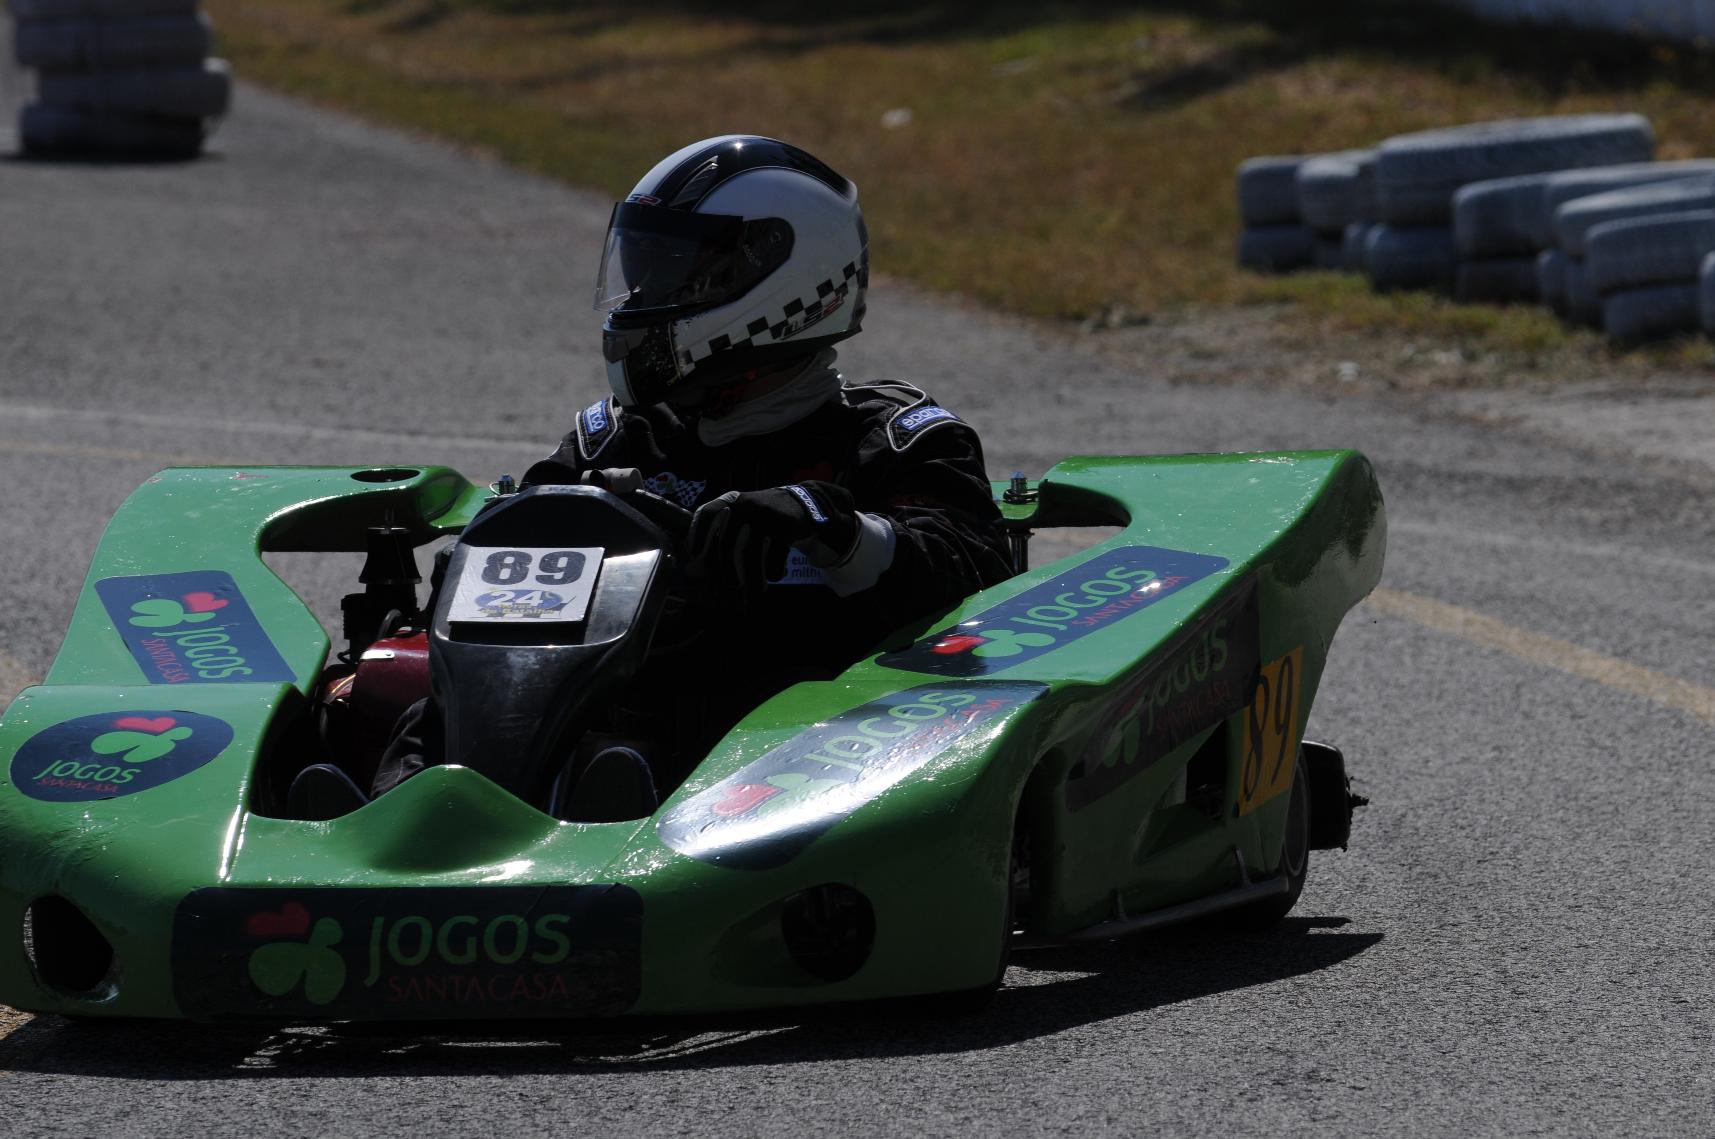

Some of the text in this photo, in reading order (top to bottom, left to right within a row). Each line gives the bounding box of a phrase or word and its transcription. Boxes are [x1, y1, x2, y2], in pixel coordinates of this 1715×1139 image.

[481, 550, 587, 586] 89
[487, 590, 545, 607] 24
[1009, 566, 1158, 631] JOGOS
[151, 626, 254, 679] JOGOS
[804, 692, 978, 770] JOGOS
[1243, 655, 1304, 802] 89
[31, 759, 142, 784] JOGOS
[363, 914, 572, 988] JOGOS
